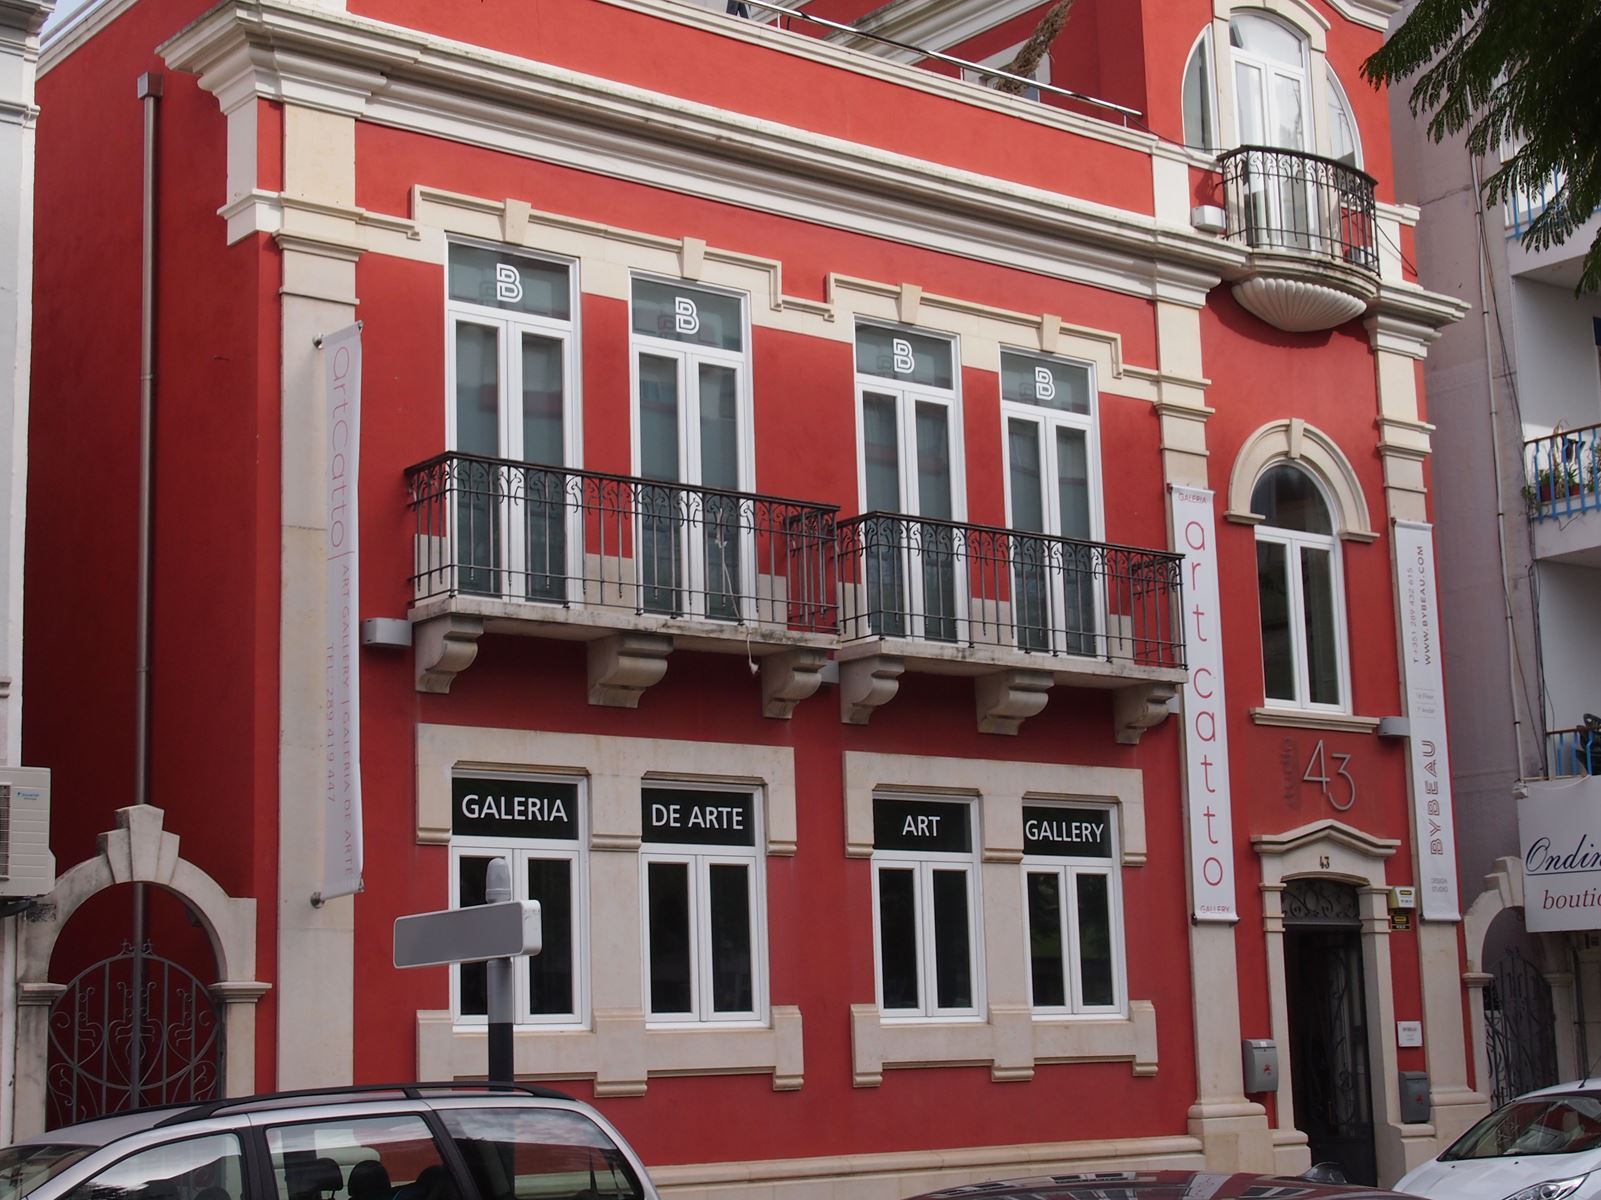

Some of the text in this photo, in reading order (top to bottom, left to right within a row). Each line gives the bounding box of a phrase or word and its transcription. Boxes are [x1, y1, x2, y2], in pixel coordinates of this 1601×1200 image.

[496, 263, 523, 303] B
[675, 296, 700, 335] B
[893, 338, 915, 374] B
[1035, 366, 1056, 400] B
[342, 565, 351, 598] ART
[1417, 545, 1431, 665] WWW.BYBEAU.COM
[341, 605, 350, 688] GALLERY
[326, 688, 335, 721] 289
[326, 728, 335, 762] 419
[342, 711, 351, 793] GALERIA
[327, 769, 336, 803] 447
[1303, 739, 1356, 811] 43
[461, 794, 568, 822] GALERIA
[1421, 740, 1443, 855] BYBEAU
[652, 803, 743, 830] DE ARTE
[902, 815, 940, 836] ART
[1025, 820, 1104, 843] GALLERY
[343, 831, 353, 877] ARTE
[1319, 856, 1330, 869] 43
